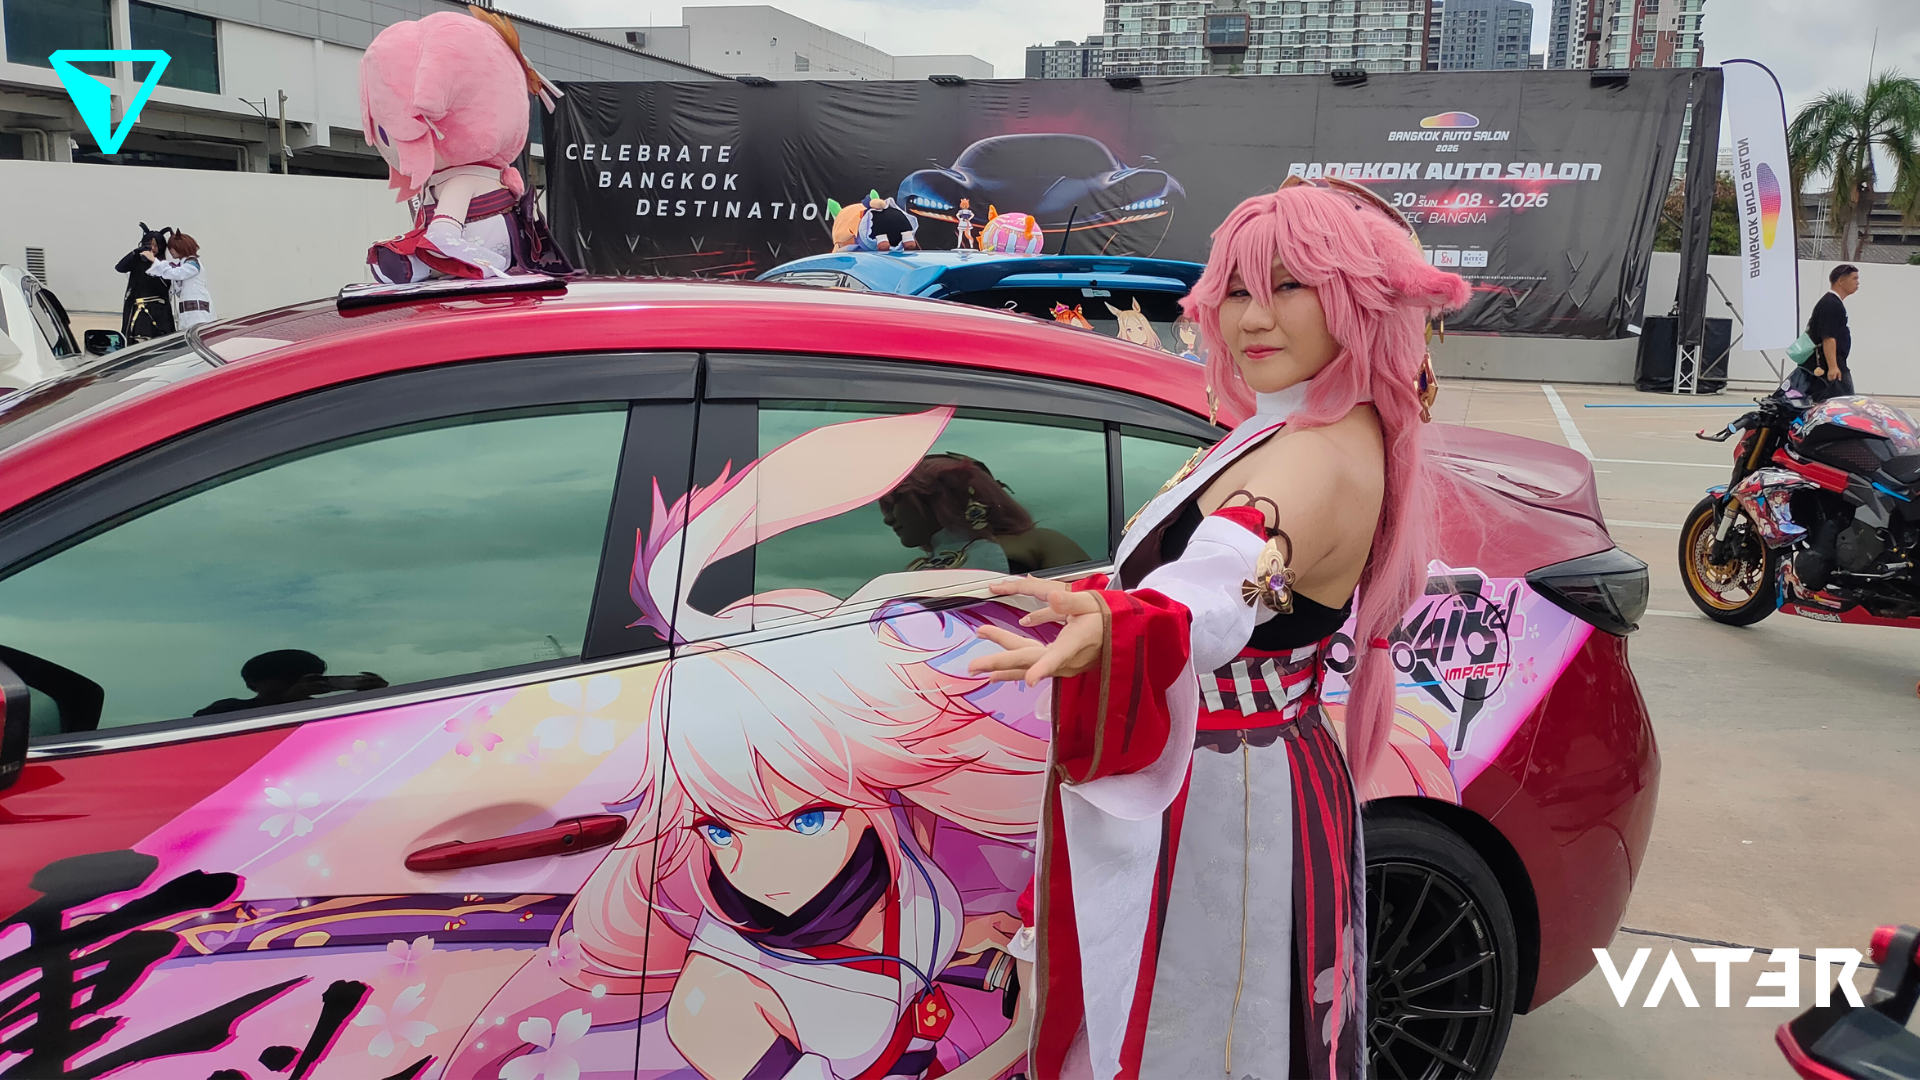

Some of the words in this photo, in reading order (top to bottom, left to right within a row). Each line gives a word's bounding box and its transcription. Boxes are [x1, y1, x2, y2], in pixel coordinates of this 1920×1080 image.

[1387, 131, 1441, 141] BANGKOK
[1441, 131, 1472, 141] AUTO
[1472, 130, 1510, 141] SALON
[565, 143, 732, 163] CELEBRATE
[1435, 144, 1459, 152] 2026
[1423, 162, 1501, 180] AUTO
[1504, 163, 1602, 181] SALON
[598, 171, 739, 191] BANGKOK
[1390, 192, 1417, 207] 30
[1418, 199, 1438, 207] SUN
[1454, 192, 1483, 207] 08
[1498, 192, 1549, 208] 2026
[1428, 212, 1487, 224] BANGNA
[1444, 662, 1511, 681] IMPACT
